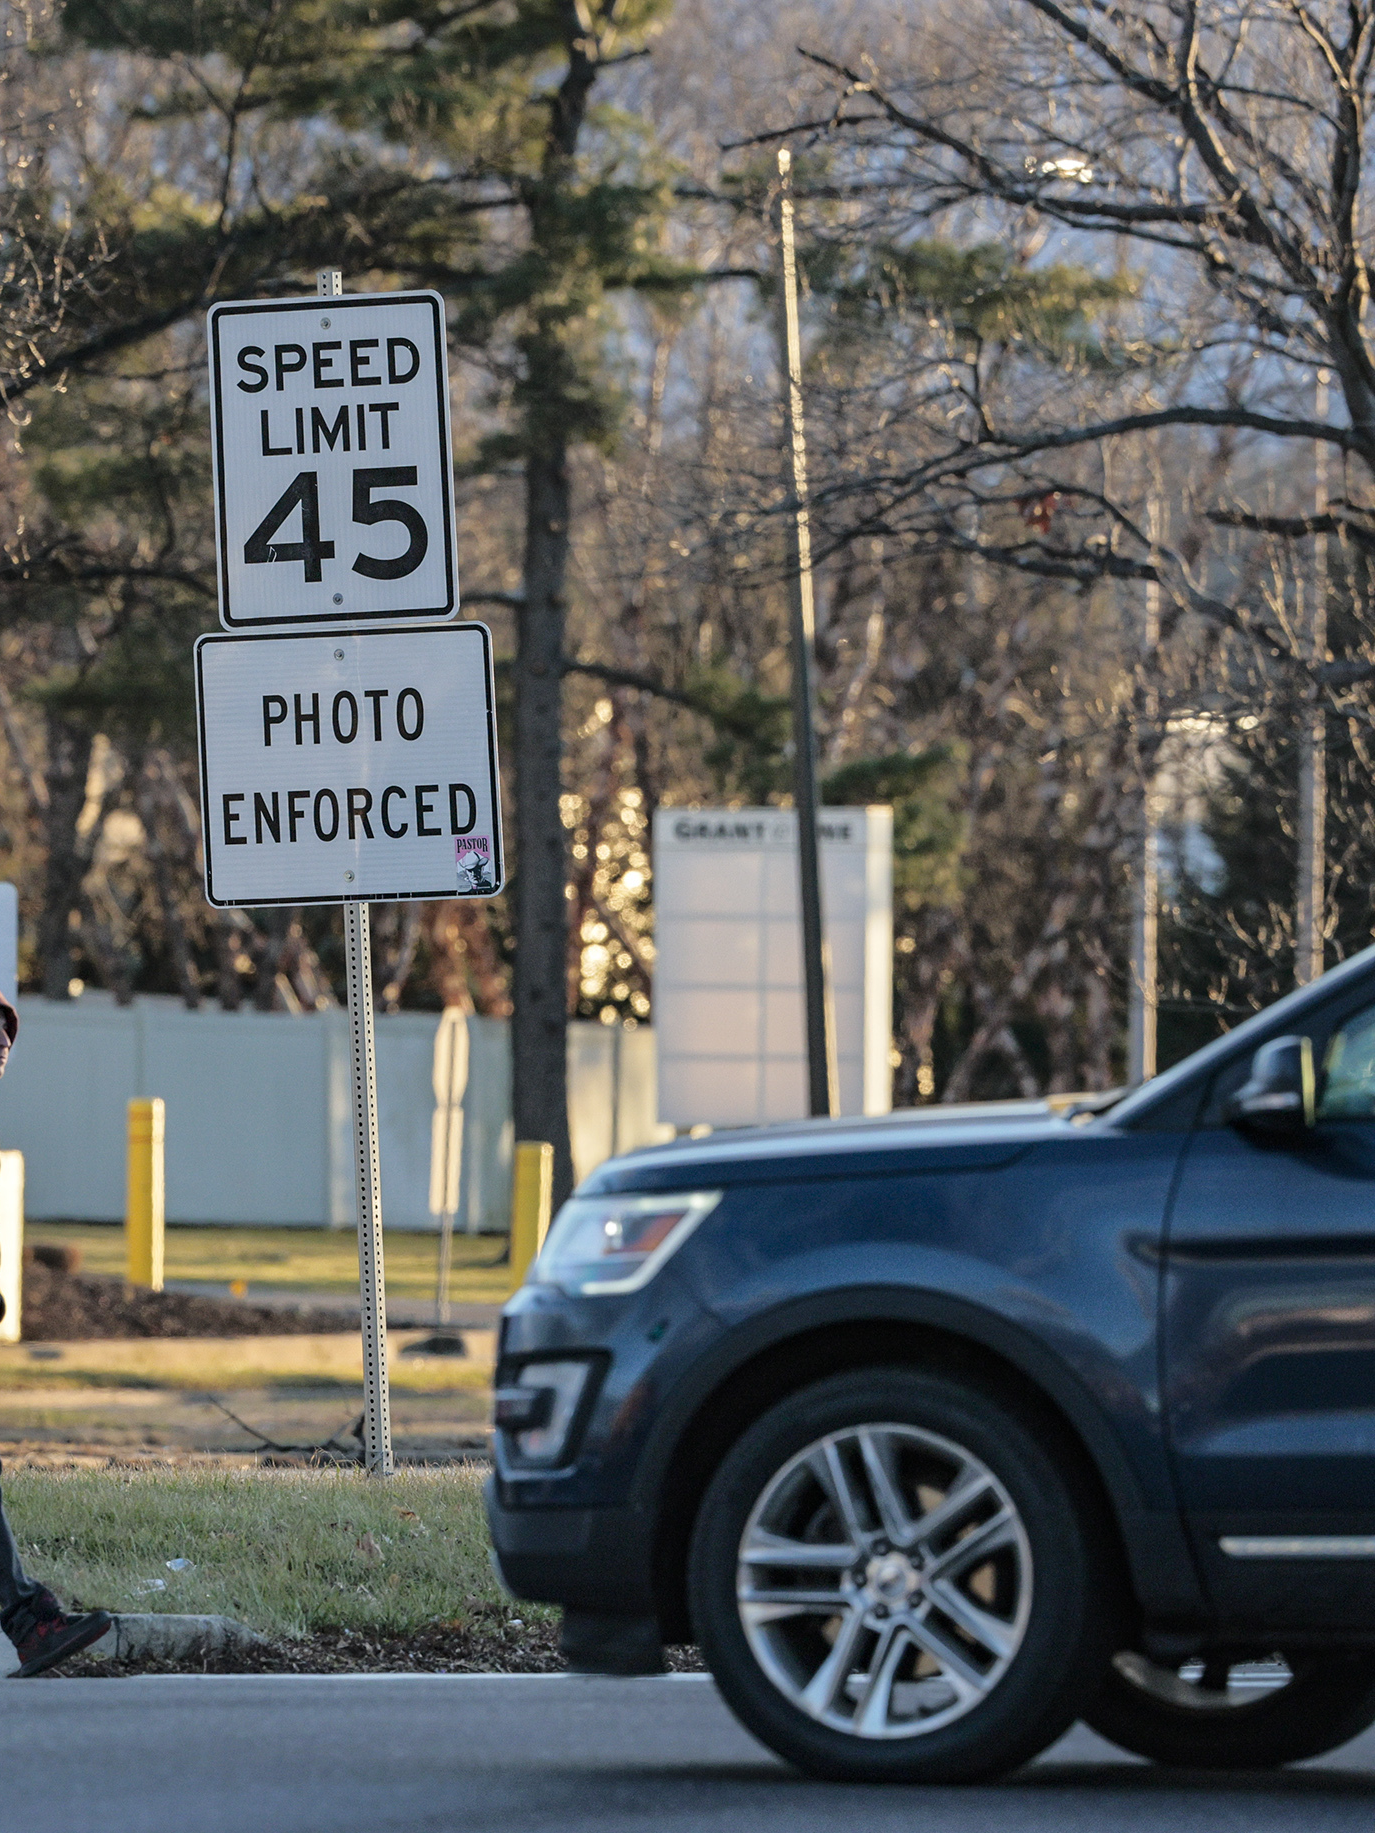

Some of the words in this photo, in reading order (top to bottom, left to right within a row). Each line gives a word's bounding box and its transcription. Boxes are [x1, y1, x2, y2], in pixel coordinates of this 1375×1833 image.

[237, 337, 420, 393] SPEED
[260, 402, 400, 456] LIMIT
[243, 466, 429, 583] 45
[262, 688, 425, 747] PHOTO
[222, 783, 477, 845] ENFORCED
[456, 837, 489, 853] PASTOR
